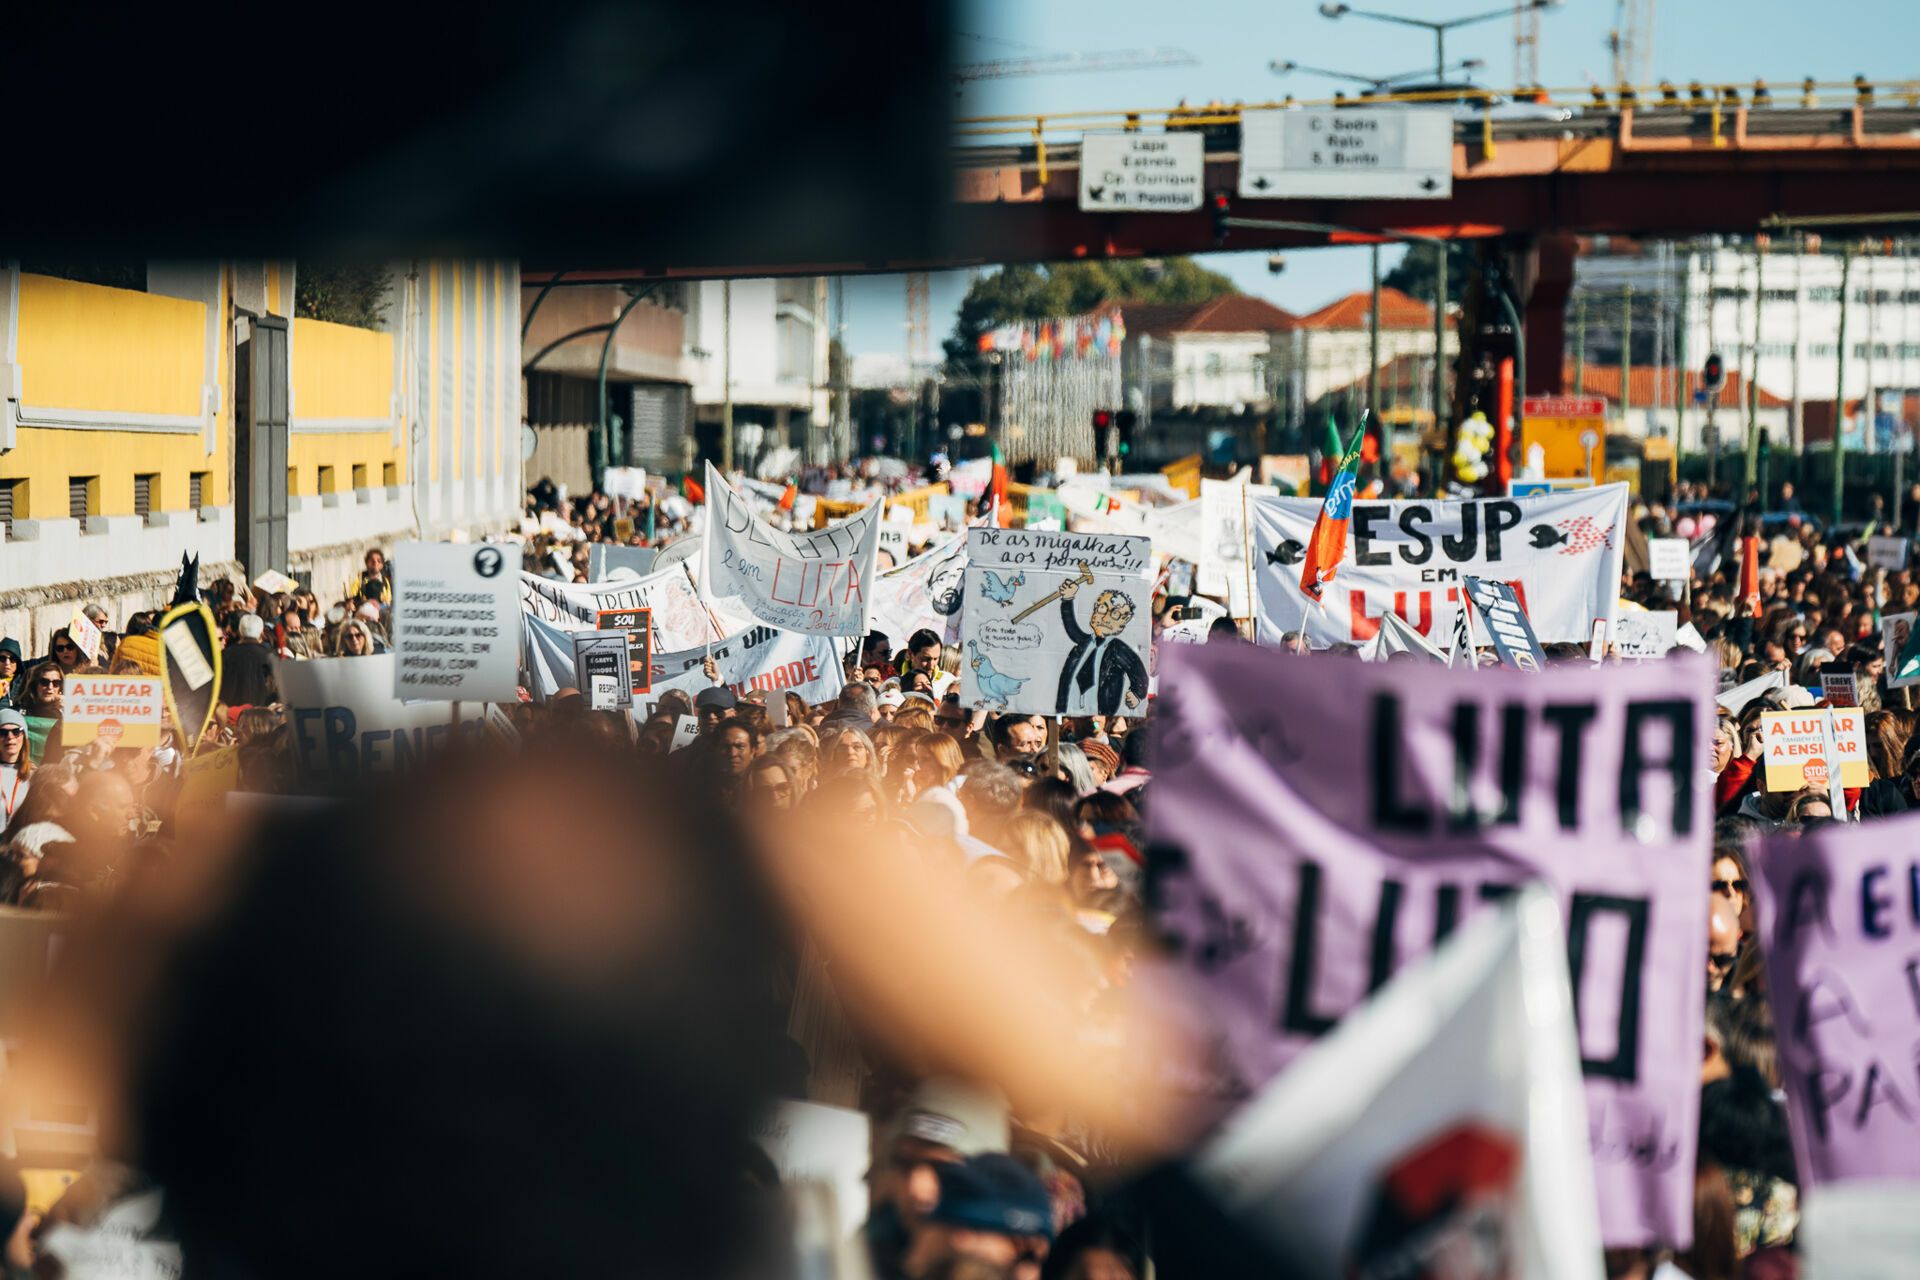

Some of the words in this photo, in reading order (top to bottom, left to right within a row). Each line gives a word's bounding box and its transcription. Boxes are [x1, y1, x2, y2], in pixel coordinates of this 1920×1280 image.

[1138, 191, 1194, 205] Pombal
[1352, 500, 1523, 566] ESJP
[979, 531, 1001, 546] Dê
[1006, 535, 1030, 548] as
[1034, 535, 1133, 558] migalhas
[1001, 551, 1036, 565] aos
[770, 557, 863, 608] LUTA
[1421, 568, 1458, 584] EM
[1350, 578, 1532, 642] LU
[614, 614, 636, 626] SOU
[1830, 676, 1852, 685] GREVE
[72, 682, 86, 696] A
[92, 683, 152, 697] LUTAR
[72, 704, 81, 716] A
[86, 704, 152, 717] ENSINAR
[1771, 721, 1786, 736] A
[1772, 745, 1784, 756] A
[1788, 741, 1857, 756] ENSIAR
[1367, 691, 1699, 839] LUTA
[1804, 765, 1829, 777] STOP
[1861, 864, 1920, 941] E
[1282, 858, 1652, 1084] LUO
[1806, 1051, 1920, 1146] PA
